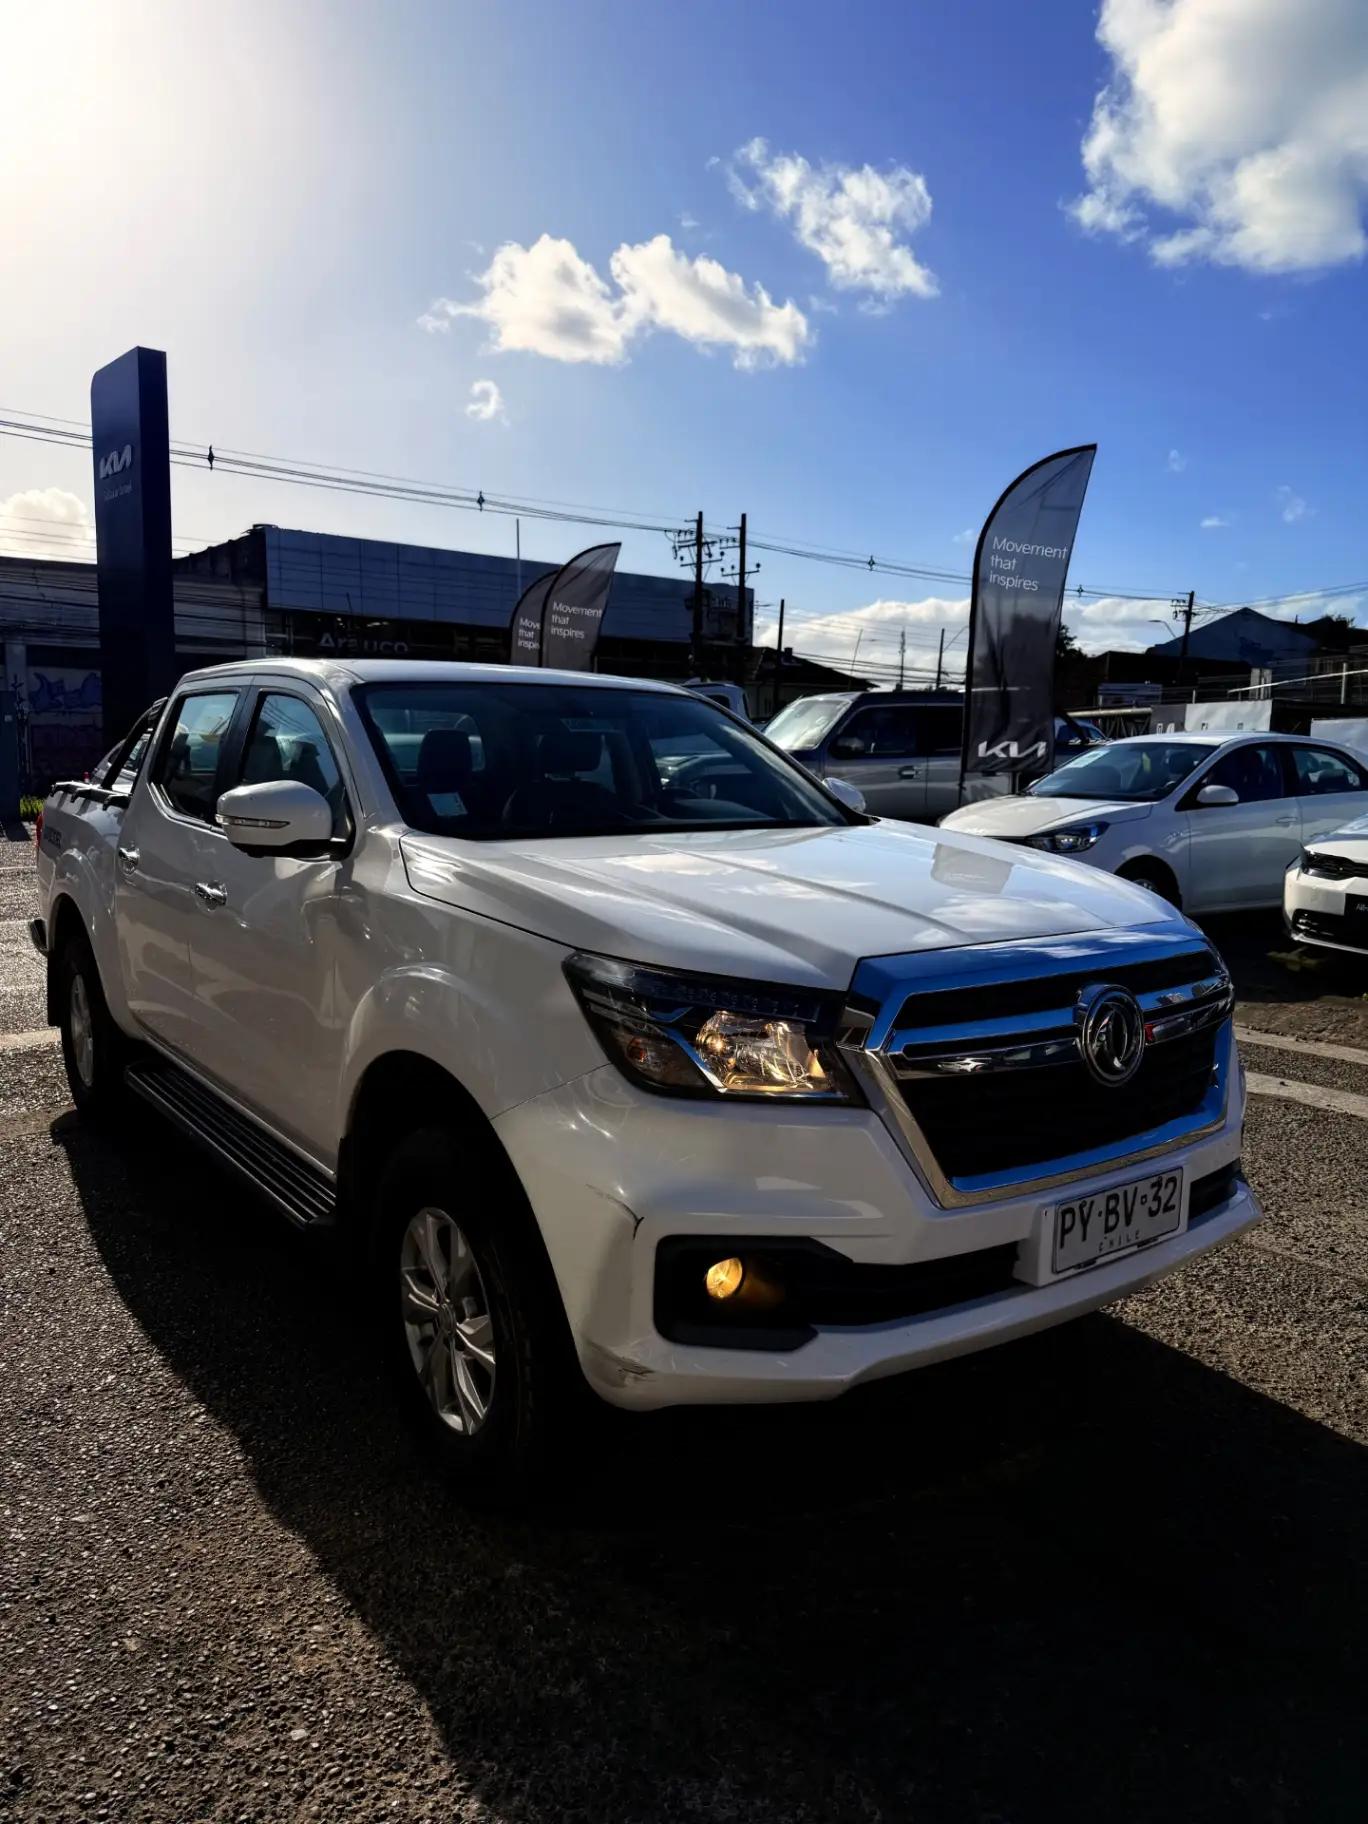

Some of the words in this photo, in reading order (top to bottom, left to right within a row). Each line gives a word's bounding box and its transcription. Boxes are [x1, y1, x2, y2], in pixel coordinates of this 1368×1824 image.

[992, 536, 1068, 560] Movement
[991, 554, 1017, 571] that
[989, 570, 1040, 591] inspires
[552, 602, 602, 618] Movement
[552, 614, 569, 625] that
[518, 628, 534, 638] that
[551, 625, 585, 640] inspires
